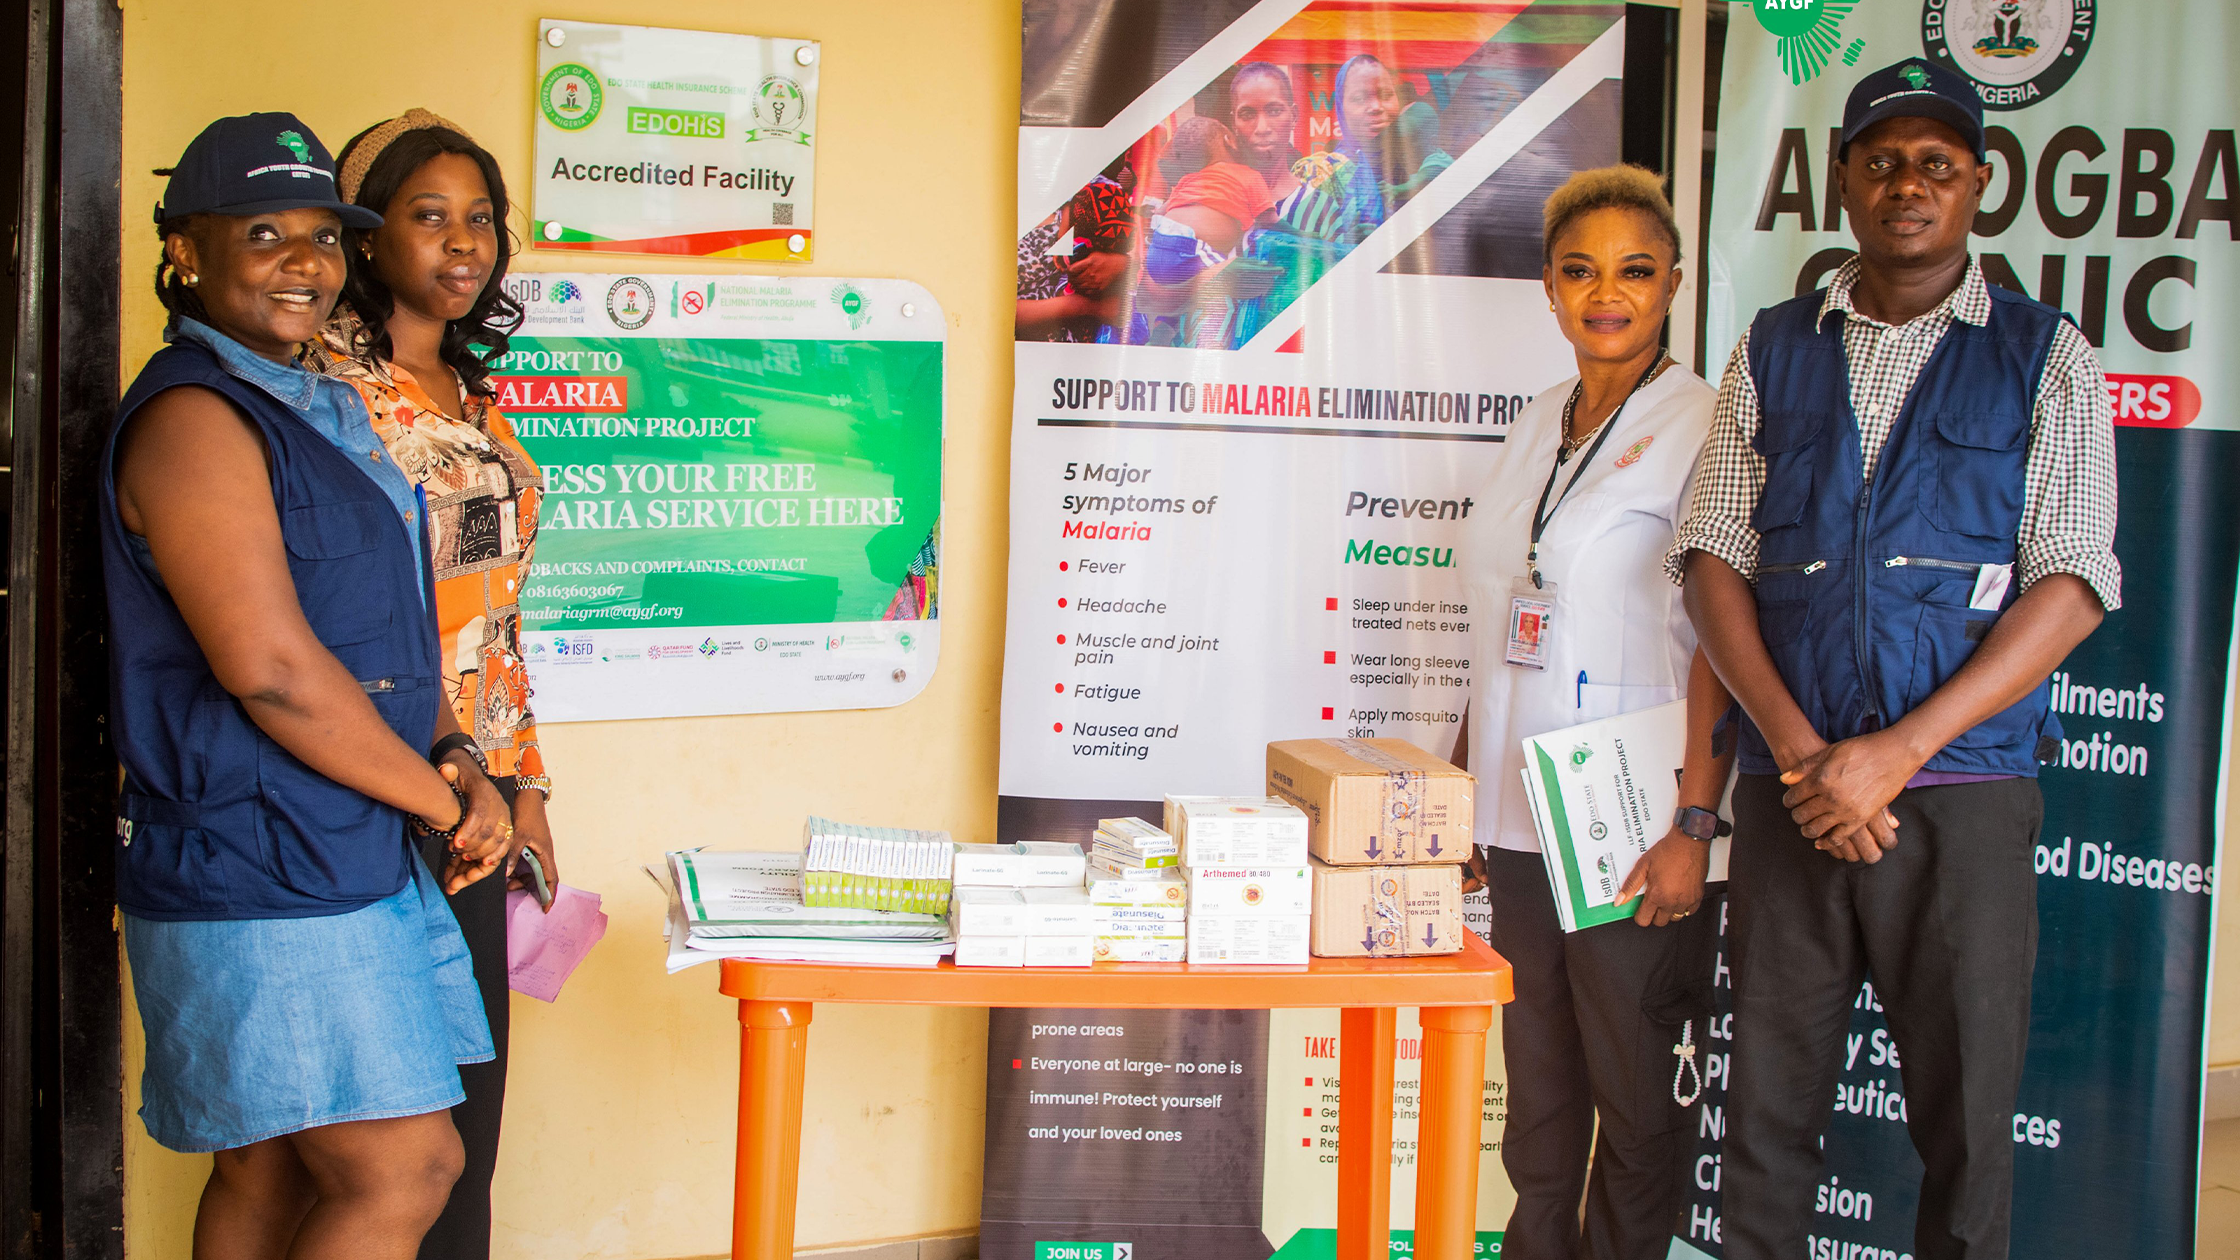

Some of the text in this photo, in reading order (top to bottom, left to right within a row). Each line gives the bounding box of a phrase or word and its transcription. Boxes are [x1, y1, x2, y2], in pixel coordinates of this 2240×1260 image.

[572, 67, 584, 76] OF
[584, 74, 598, 90] EDO
[607, 78, 748, 96] EDO STATE HEALTH INSURANCE SCHEME
[588, 93, 600, 117] STATE
[554, 115, 587, 128] NIGERIA
[551, 157, 795, 198] Accredited Facility
[1755, 125, 2240, 242] AOGBA
[610, 277, 628, 296] STATE
[627, 276, 655, 311] GOVERNMENT
[720, 285, 793, 296] NATIONAL MALARIA
[720, 298, 817, 309] ELIMINATION PROGRAMME
[528, 315, 568, 325] Development
[569, 316, 585, 324] Bank
[616, 319, 645, 330] NIGERIA
[480, 351, 623, 371] PPORT TO
[491, 382, 622, 407] ALARIA
[1052, 377, 1161, 413] SUPPORT
[1166, 380, 1196, 414] TO
[1202, 382, 1312, 418] MALARIA
[1317, 386, 1471, 424] ELIMINATION
[507, 417, 755, 438] MINATION PROJECT
[538, 463, 816, 495] ESS YOUR FREE
[1063, 462, 1151, 487] 5 Major
[646, 497, 904, 529] SERVICE HERE
[1062, 493, 1219, 518] symptoms of
[1345, 490, 1474, 521] Prevent
[1062, 520, 1151, 542] Malaria
[1344, 538, 1457, 569] Measu
[529, 557, 807, 577] DBACKS AND COMPLAINTS, CONTACT
[1077, 558, 1126, 576] Fever
[526, 583, 625, 600] 08163603067
[1076, 597, 1167, 615] Headache
[1352, 598, 1468, 616] Sleep under inse
[1352, 616, 1470, 634] treated nets ever
[572, 643, 593, 656] ISFD
[1075, 632, 1219, 654] Muscle and joint
[1074, 650, 1114, 667] pain
[1350, 653, 1470, 672] Wear long sleeve
[814, 671, 865, 682] www.aygf.org
[1350, 671, 1463, 690] especially in the
[1073, 683, 1141, 703] Fatigue
[2050, 671, 2164, 724] ilments
[1348, 707, 1459, 728] Apply mosquito
[1072, 721, 1179, 740] Nausea and
[1347, 726, 1375, 739] skin
[1072, 742, 1149, 760] vomiting
[1614, 738, 1631, 777] PROJECT
[1613, 774, 1621, 788] FOR
[1584, 785, 1594, 805] STATE
[1617, 789, 1628, 818] SUPPORT
[1639, 788, 1651, 822] EDO STATE
[1589, 805, 1597, 822] EDO
[1624, 779, 1644, 836] ELIMINATION
[1202, 869, 1247, 878] Arthemed
[2078, 840, 2214, 895] Diseases
[1600, 877, 1613, 898] IsDB
[1112, 910, 1165, 920] Diasunate
[1111, 923, 1165, 932] Diaunate
[1031, 1023, 1124, 1039] prone areas
[1304, 1036, 1423, 1060] TAKE TODA
[1031, 1056, 1243, 1077] Everyone at large- no one is
[1322, 1077, 1340, 1088] Vis
[1029, 1090, 1222, 1112] immune! Protect yourself
[1028, 1125, 1183, 1145] and your loved ones
[1480, 1141, 1501, 1151] earl
[1046, 1247, 1102, 1260] JOIN US
